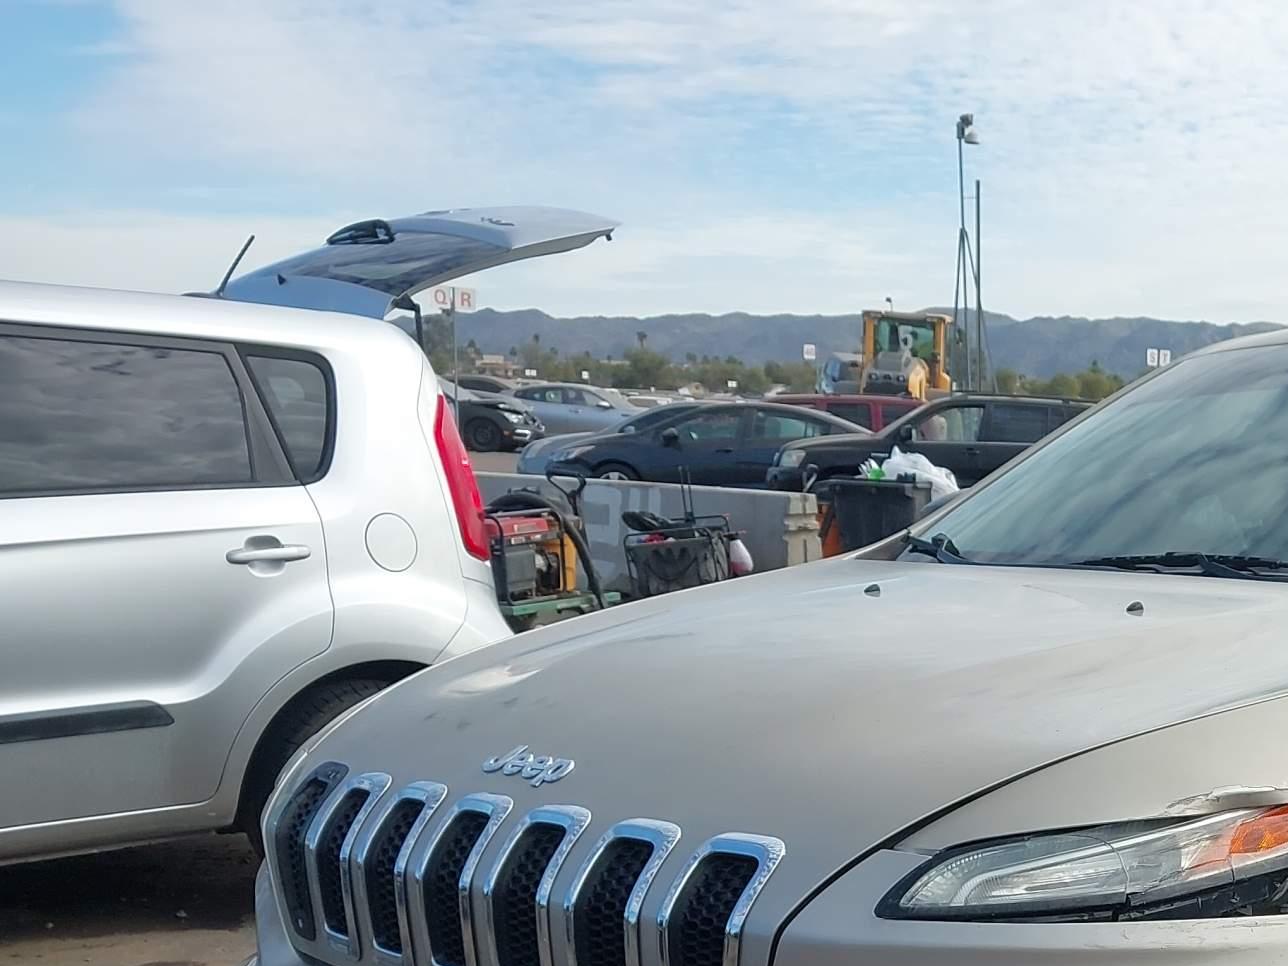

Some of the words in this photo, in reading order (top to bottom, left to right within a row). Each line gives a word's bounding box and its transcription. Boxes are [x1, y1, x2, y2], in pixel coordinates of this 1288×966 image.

[434, 289, 448, 305] Q
[460, 291, 472, 307] R
[482, 745, 575, 787] Jeep
